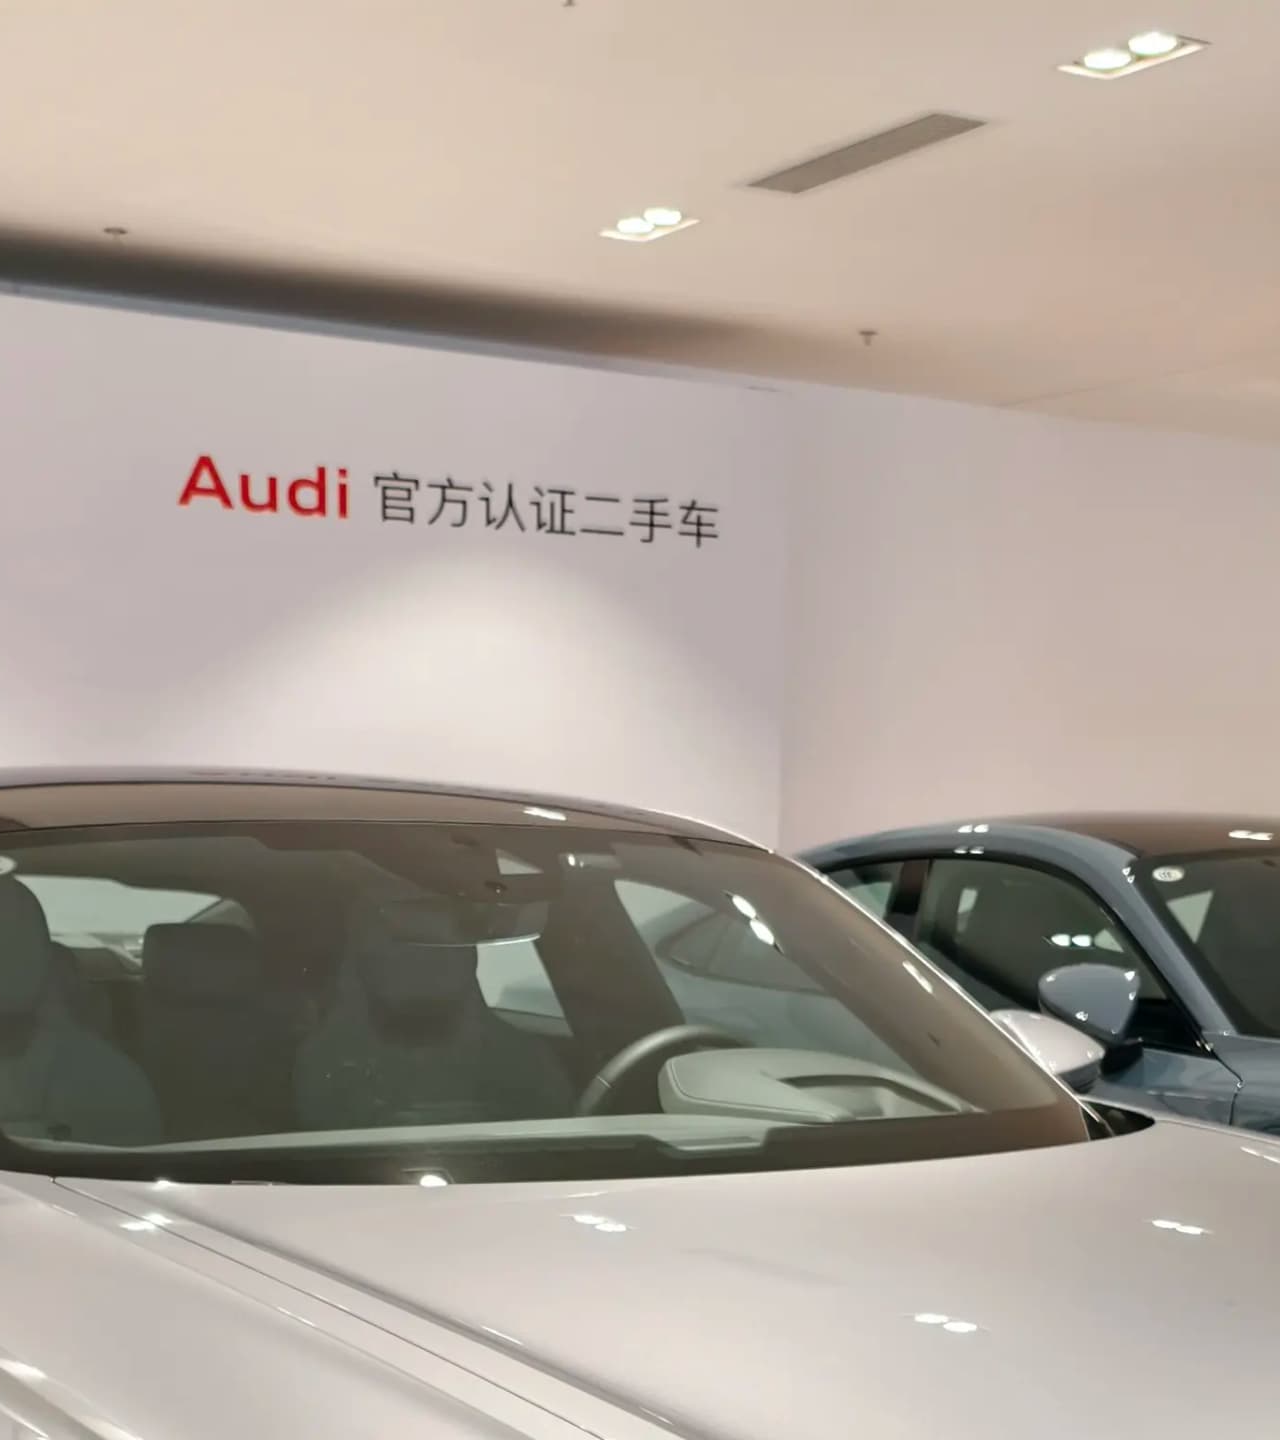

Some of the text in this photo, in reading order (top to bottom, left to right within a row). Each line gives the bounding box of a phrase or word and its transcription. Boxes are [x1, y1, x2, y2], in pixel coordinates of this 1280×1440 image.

[178, 454, 719, 548] Audi 官方认证二手车
